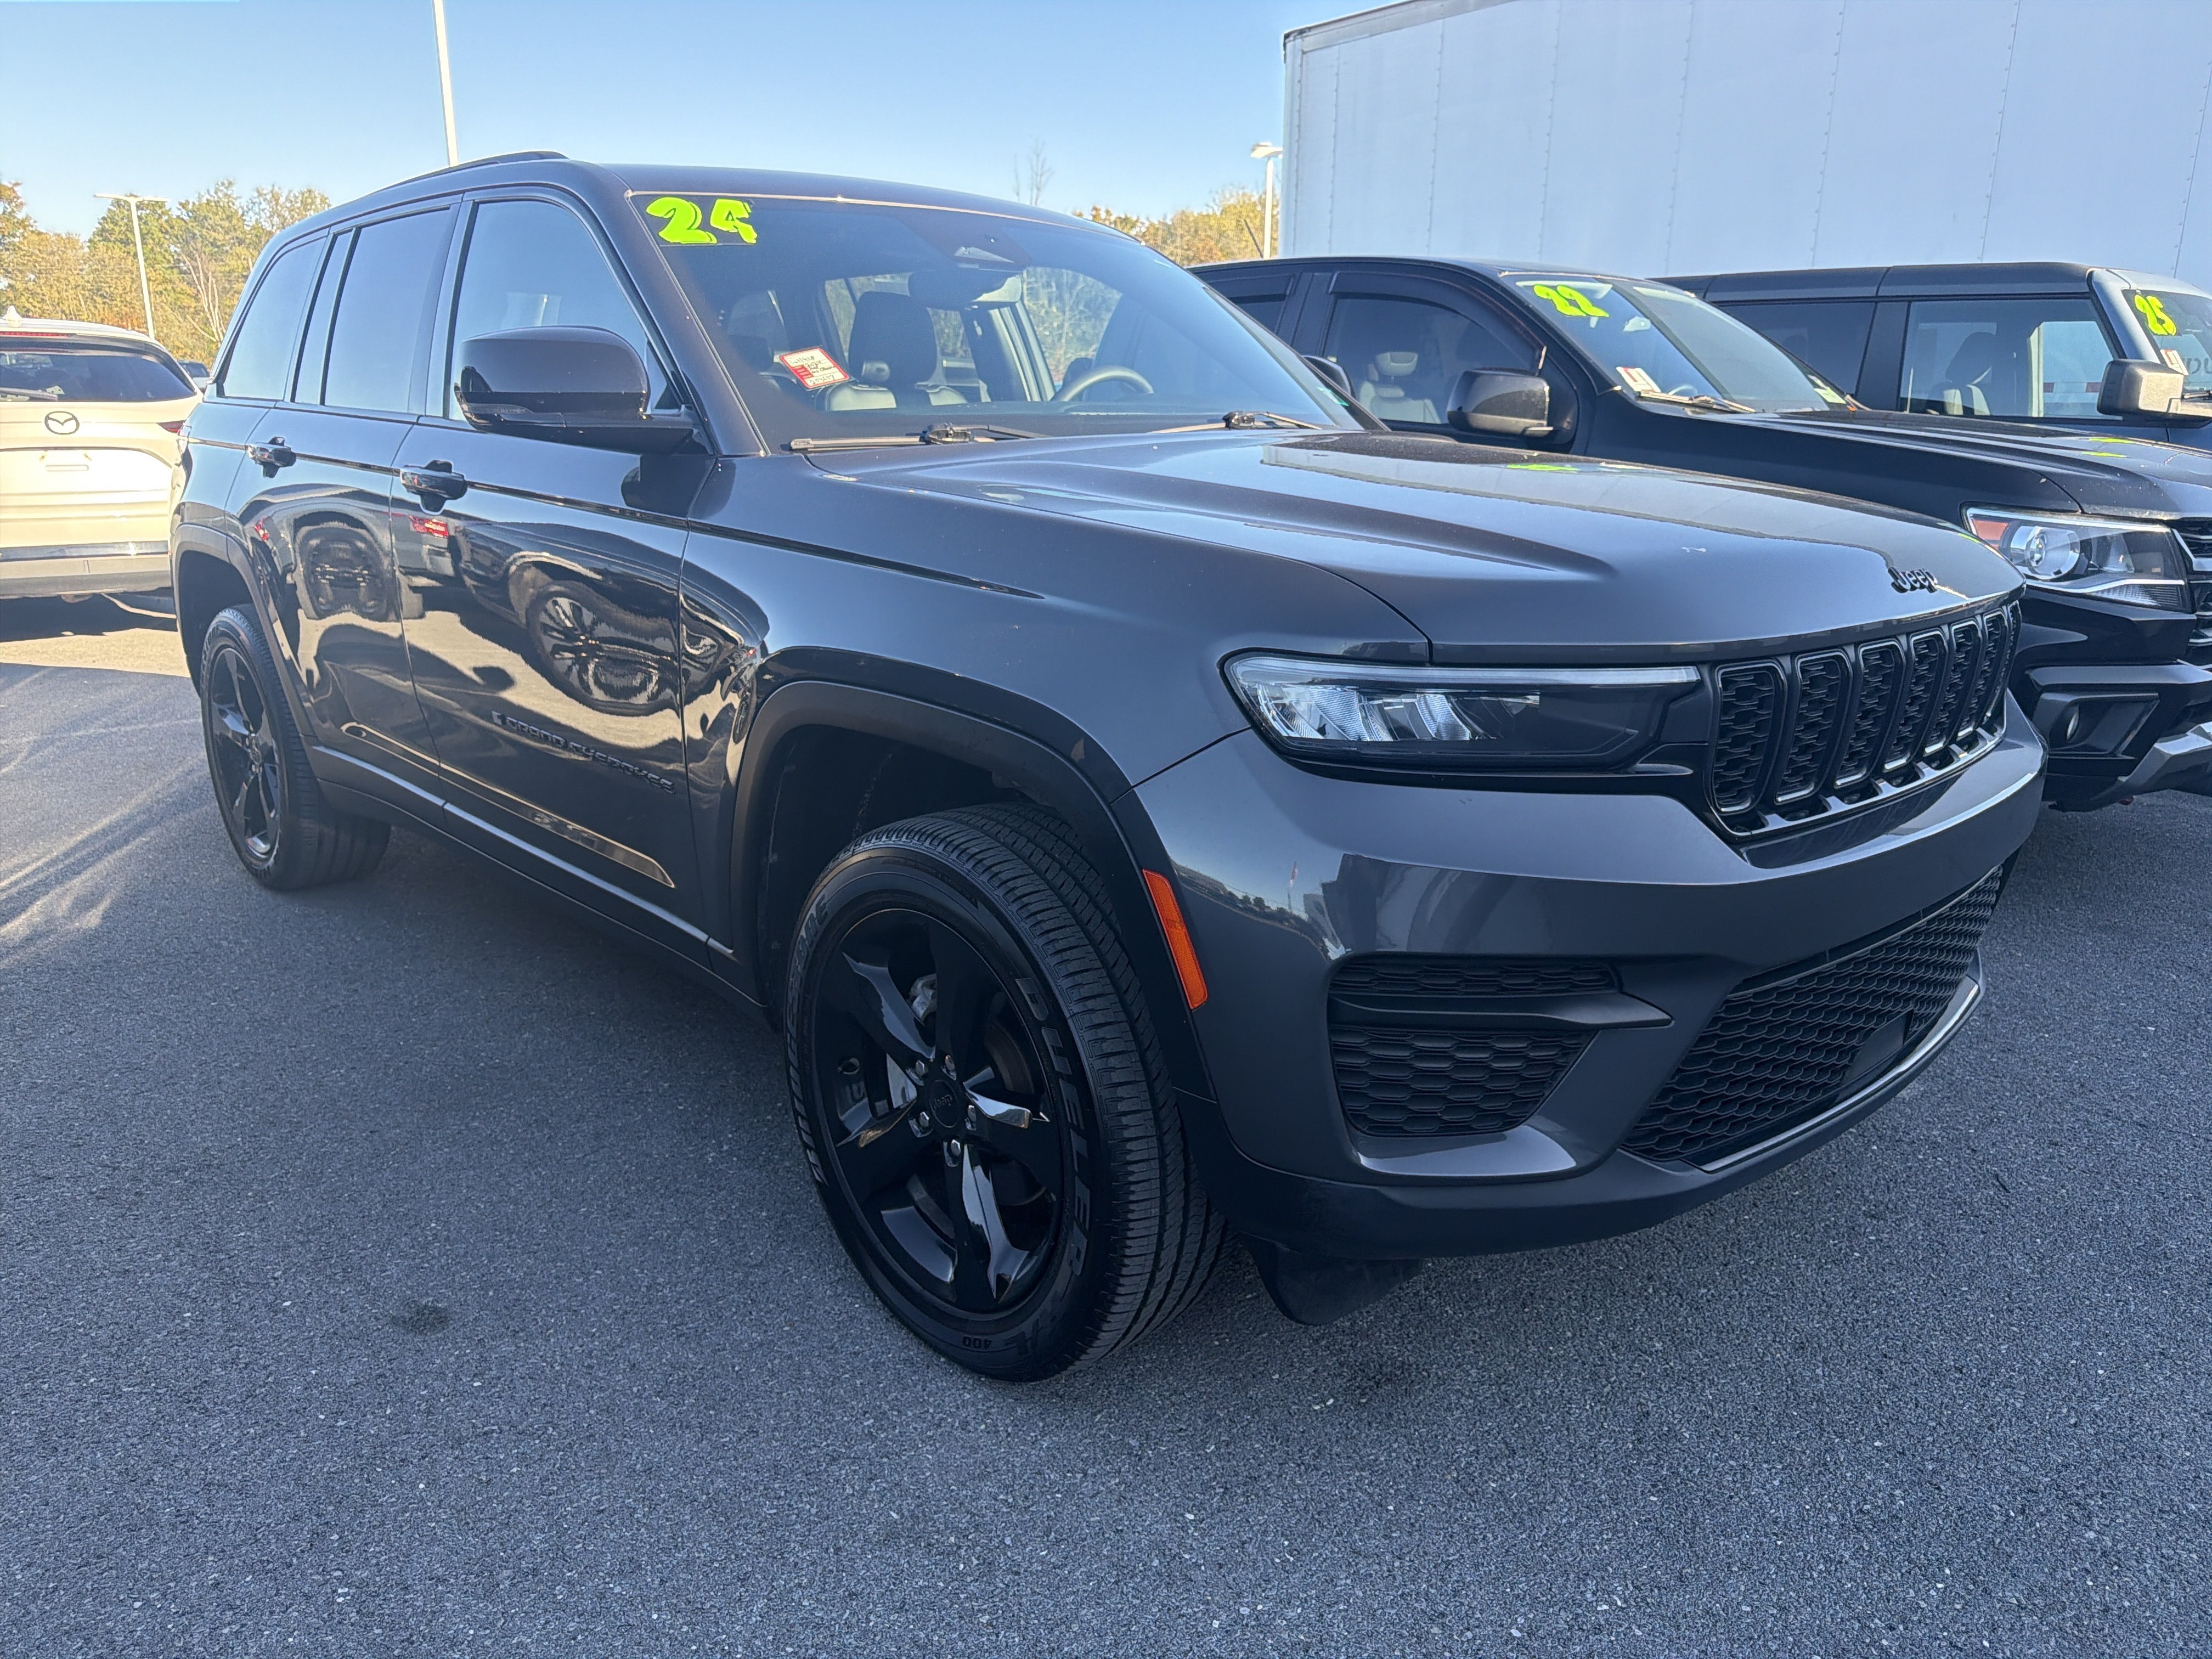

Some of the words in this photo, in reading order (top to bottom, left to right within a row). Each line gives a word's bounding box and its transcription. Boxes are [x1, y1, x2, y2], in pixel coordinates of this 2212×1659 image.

[1533, 284, 1610, 317] 22
[2134, 295, 2177, 336] 25
[1888, 567, 1938, 593] Jeep
[1015, 978, 1091, 1276] DUELER
